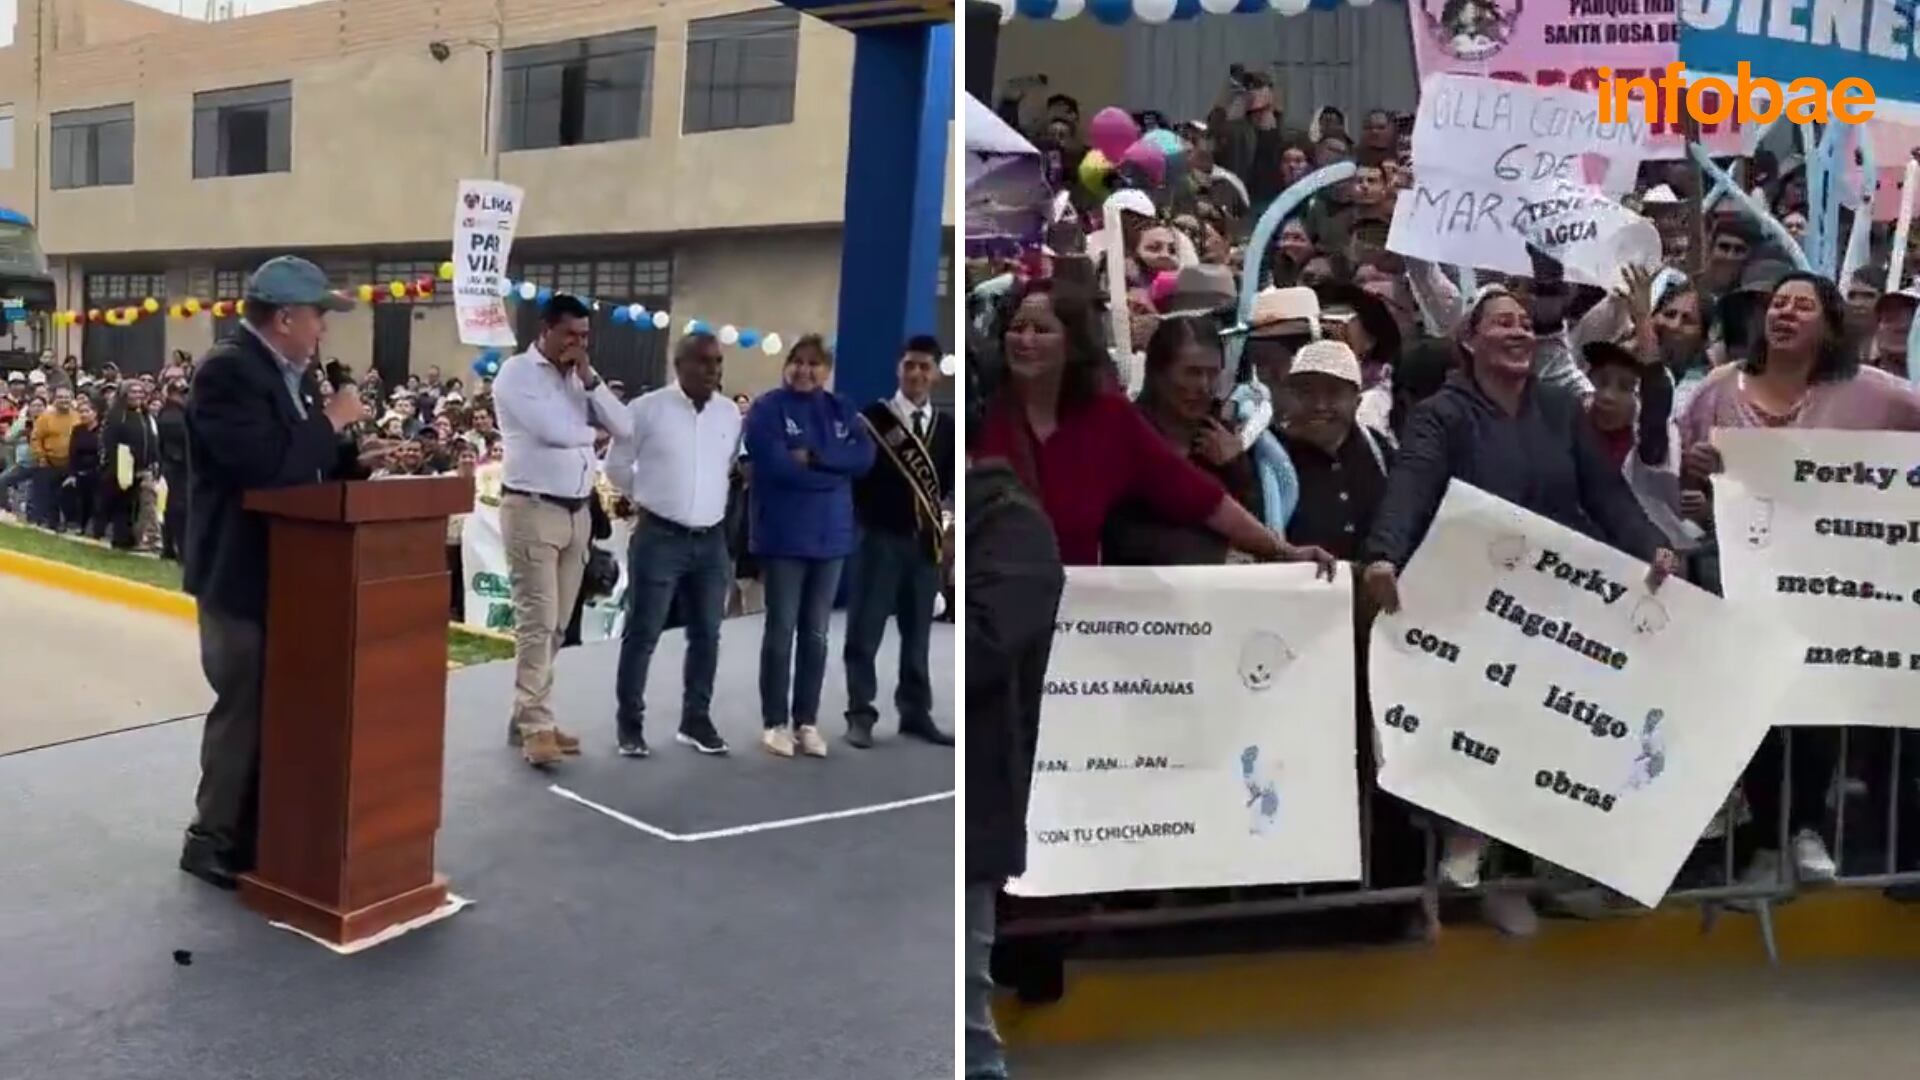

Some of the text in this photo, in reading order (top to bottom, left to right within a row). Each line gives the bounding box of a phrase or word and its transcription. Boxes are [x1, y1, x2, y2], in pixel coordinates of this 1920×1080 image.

[1544, 24, 1601, 44] SANTA
[1605, 24, 1655, 44] ROSA
[1433, 91, 1512, 130] OLLA
[1494, 143, 1579, 181] 6 DE
[1544, 220, 1598, 246] AGUA
[1534, 549, 1628, 604] Porky
[1076, 620, 1138, 635] QUIERO
[1143, 620, 1212, 635] CONTIGO
[1485, 589, 1629, 670] flagelame
[1805, 646, 1901, 669] metas
[1081, 681, 1109, 696] LAS
[1112, 675, 1195, 696] MAÑANAS
[1405, 627, 1629, 739] con el látigo
[1385, 704, 1617, 812] de tus obras
[1037, 821, 1195, 844] CON TU CHICHARRON
